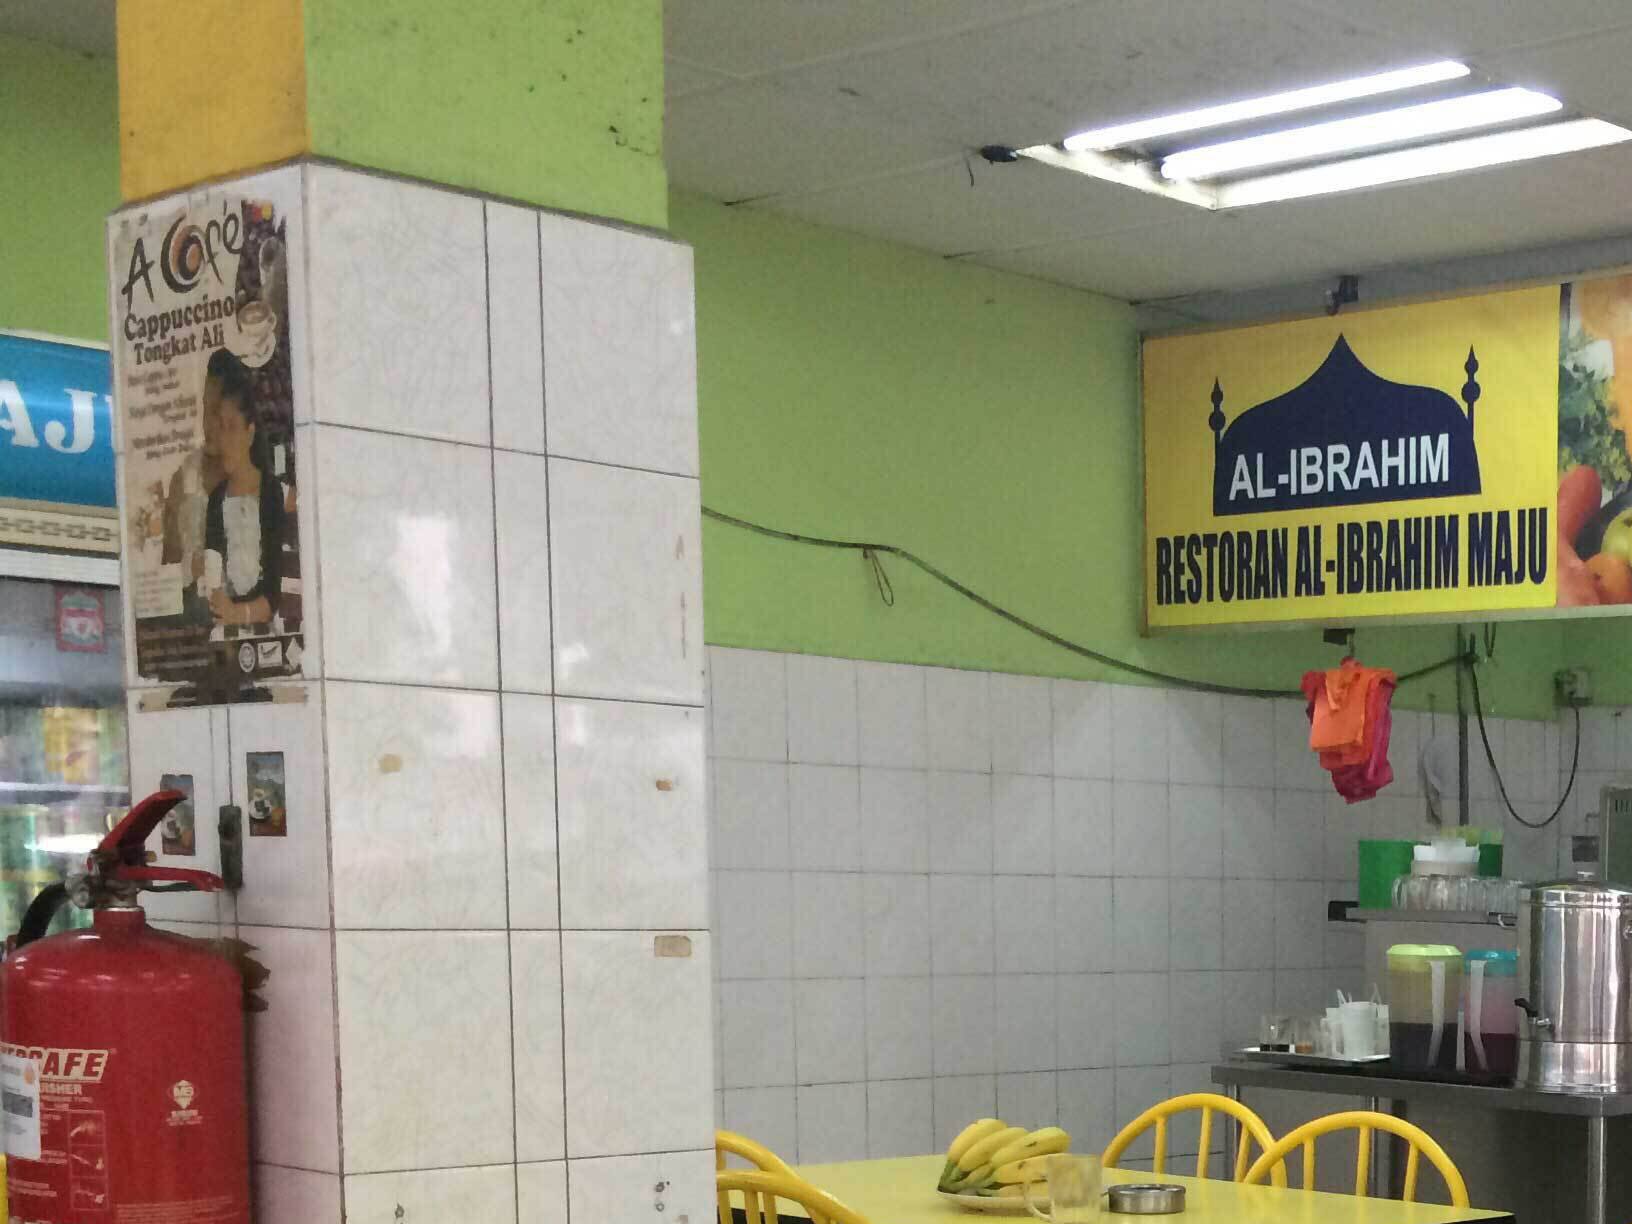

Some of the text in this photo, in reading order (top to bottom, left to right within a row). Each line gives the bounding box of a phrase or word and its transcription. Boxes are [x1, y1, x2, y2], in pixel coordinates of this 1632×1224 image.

[124, 295, 234, 342] Cappuccino
[134, 323, 225, 366] Tongkat Ali
[1229, 433, 1450, 501] AL-IBRAHIM
[1156, 507, 1548, 606] RESTORAN AL-IBRAHIM MAJU
